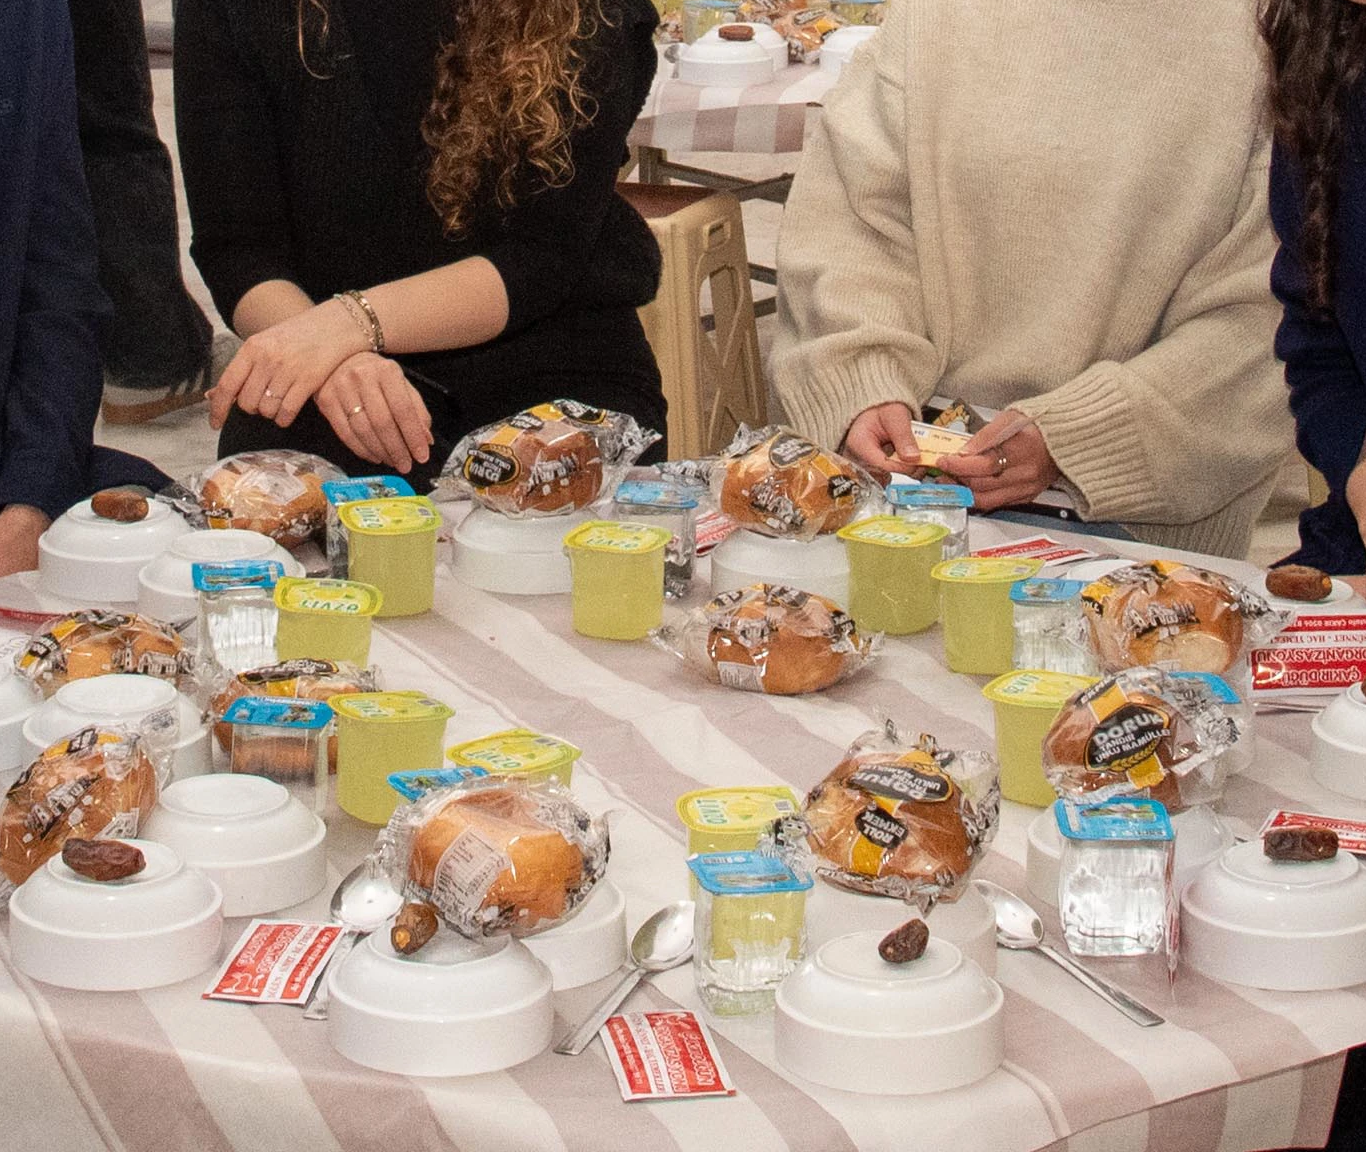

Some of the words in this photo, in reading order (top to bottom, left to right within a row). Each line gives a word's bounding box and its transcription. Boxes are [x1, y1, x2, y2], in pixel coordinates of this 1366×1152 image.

[1318, 665, 1361, 683] ÇAKIR
[1093, 713, 1164, 747] DORUK
[861, 811, 906, 838] EKMEK
[862, 823, 895, 845] ROLL
